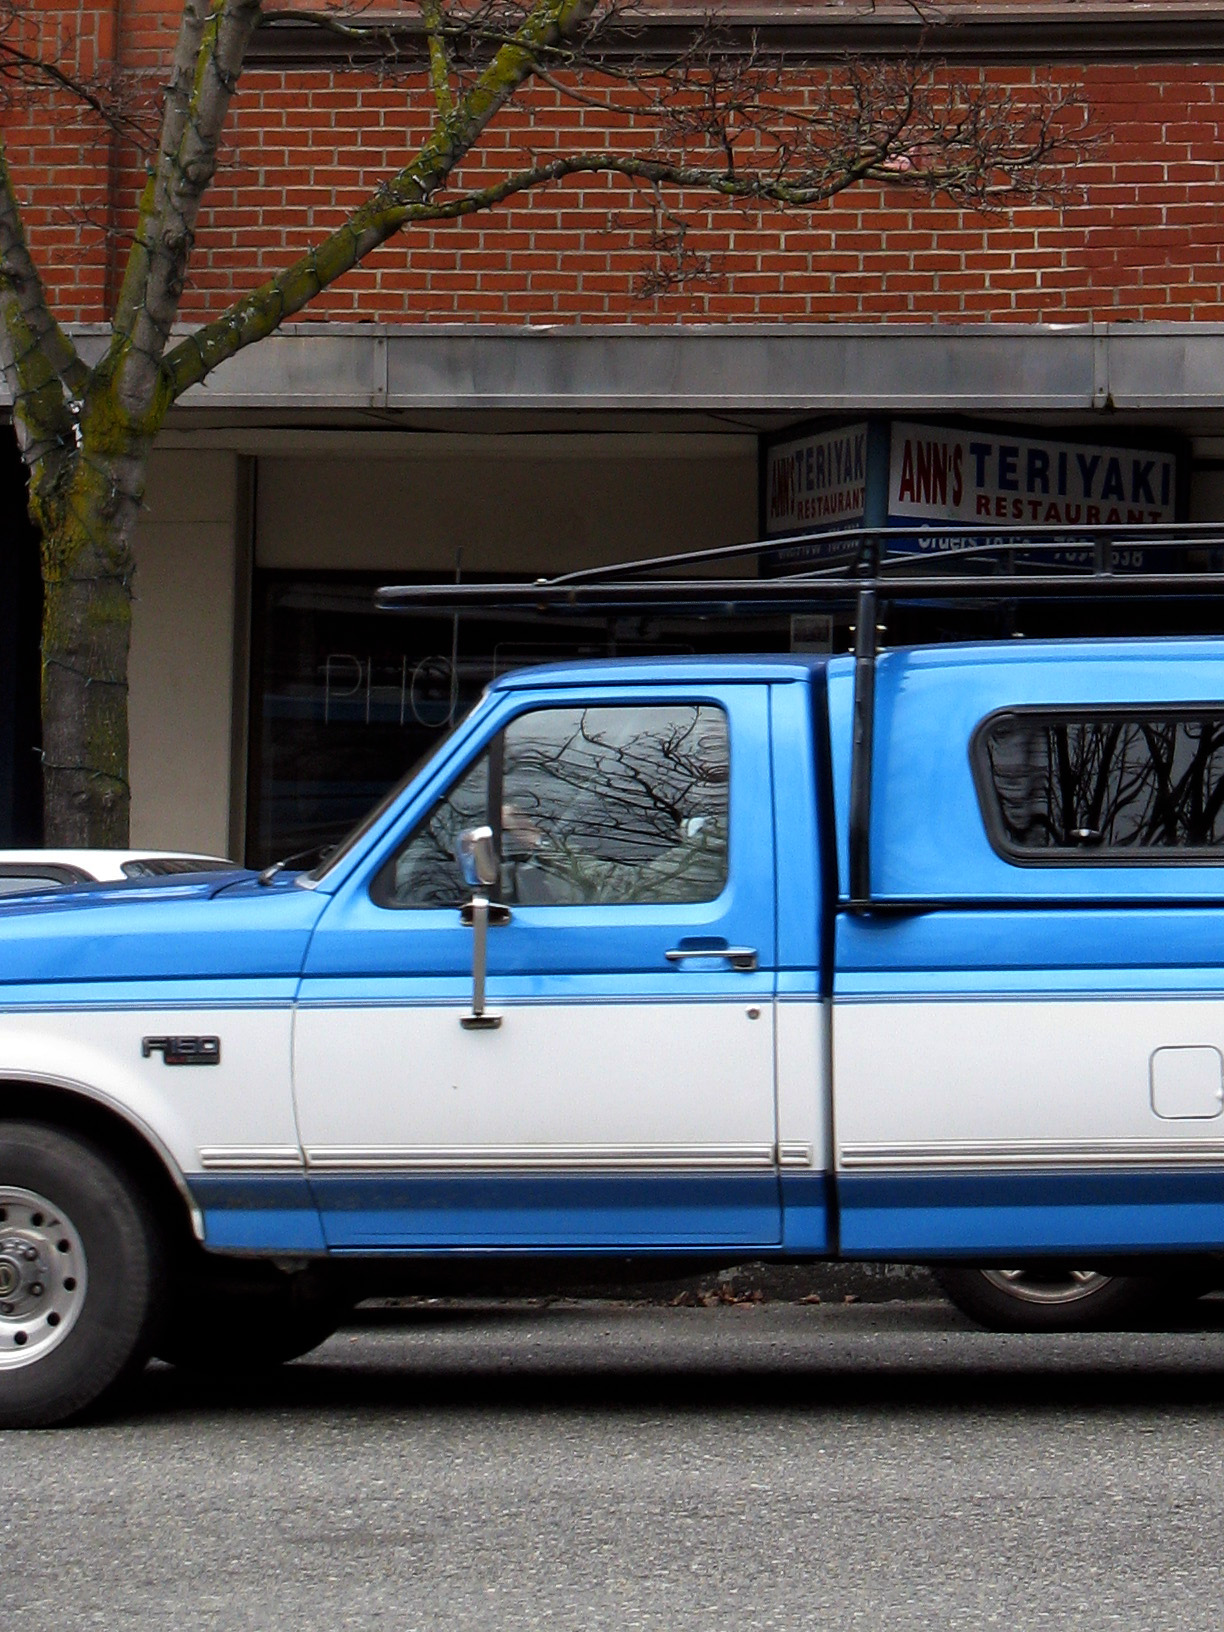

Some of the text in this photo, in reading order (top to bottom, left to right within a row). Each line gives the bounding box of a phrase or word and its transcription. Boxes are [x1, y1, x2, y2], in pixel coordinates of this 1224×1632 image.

[795, 434, 864, 493] TERIYAK
[899, 439, 1171, 507] ANN'S TERIYAKI
[976, 493, 1163, 525] RESTAURANT
[324, 654, 460, 728] PHO
